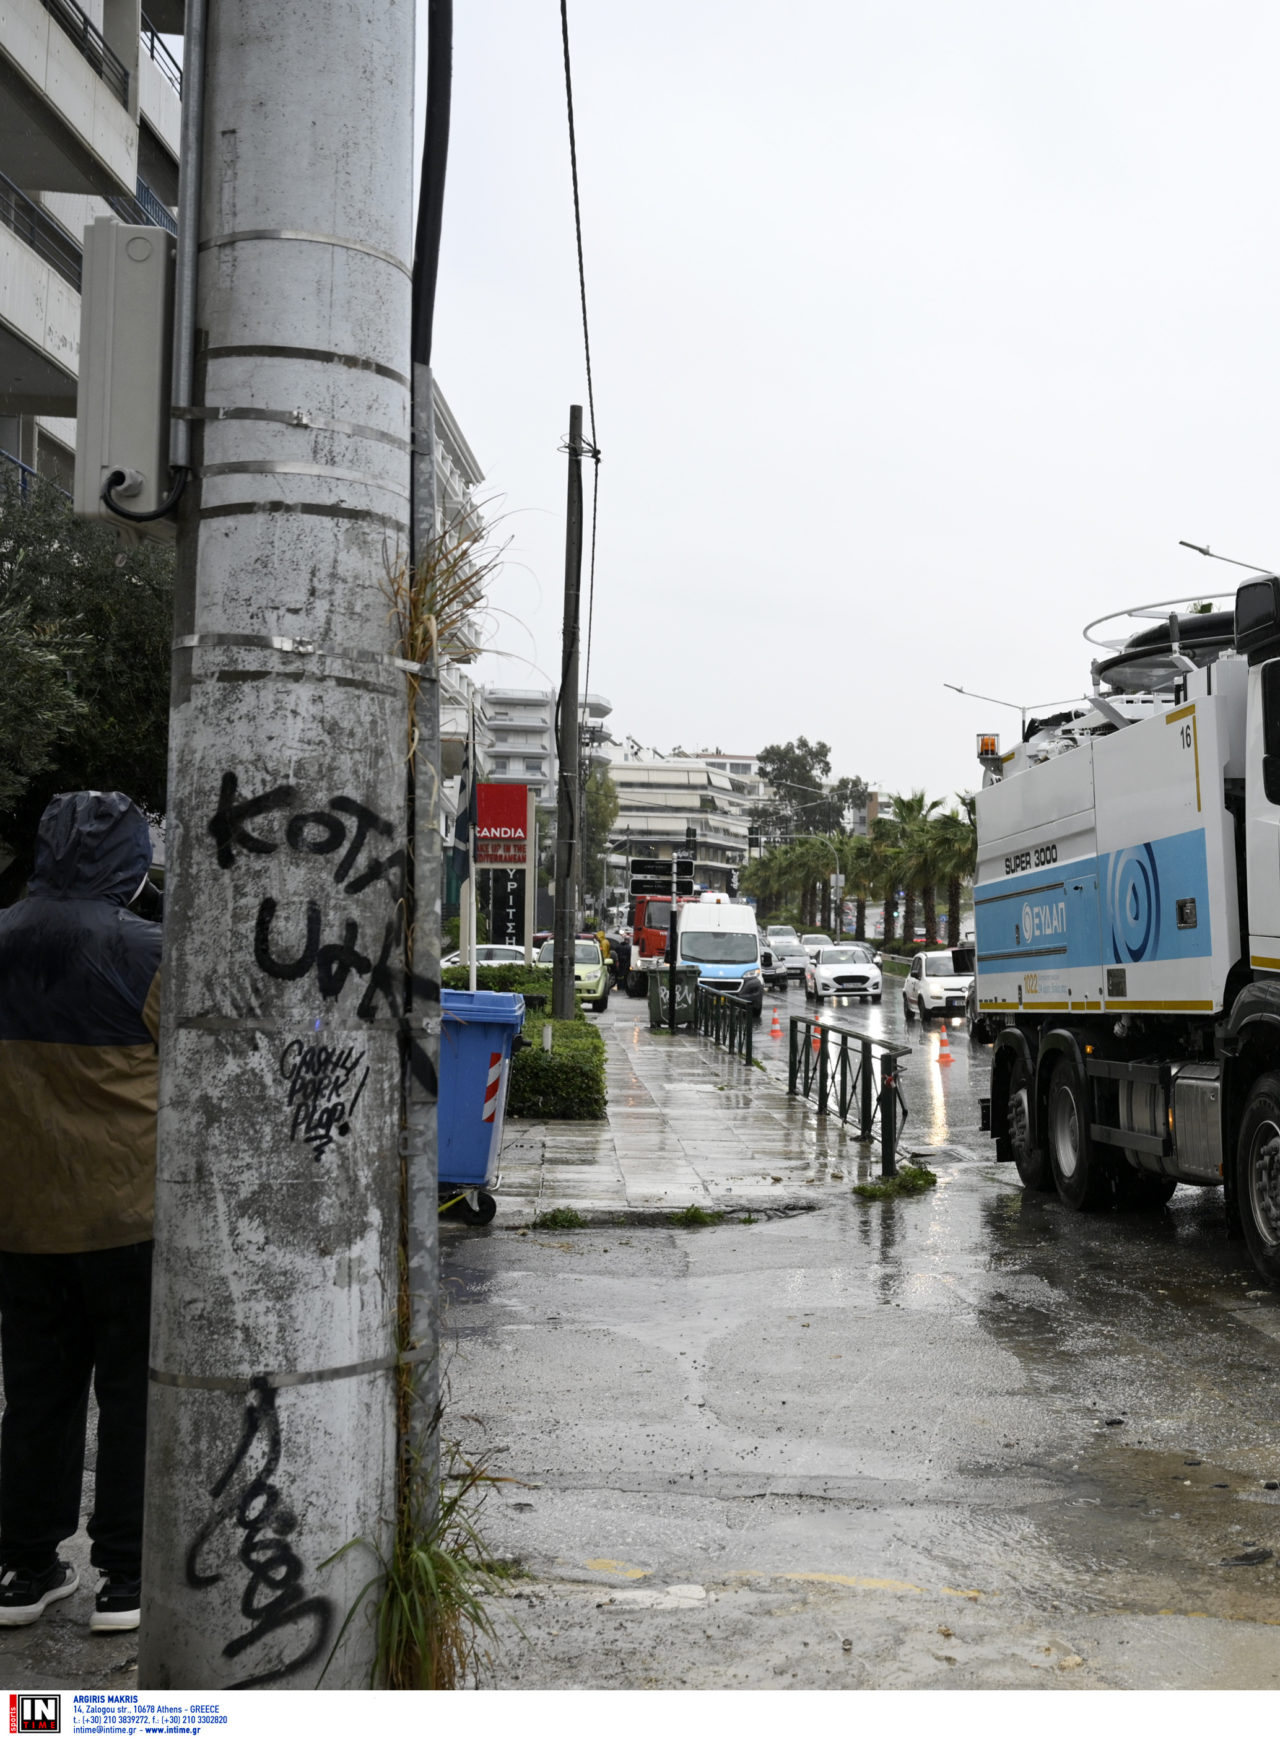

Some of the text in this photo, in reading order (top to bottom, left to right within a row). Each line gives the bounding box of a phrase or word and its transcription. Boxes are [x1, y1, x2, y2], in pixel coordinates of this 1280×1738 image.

[1181, 725, 1191, 749] 16
[1005, 844, 1058, 875] SUPER 3000
[1033, 902, 1067, 936] ΕΥΔΑΠ
[1024, 973, 1038, 994] 1022
